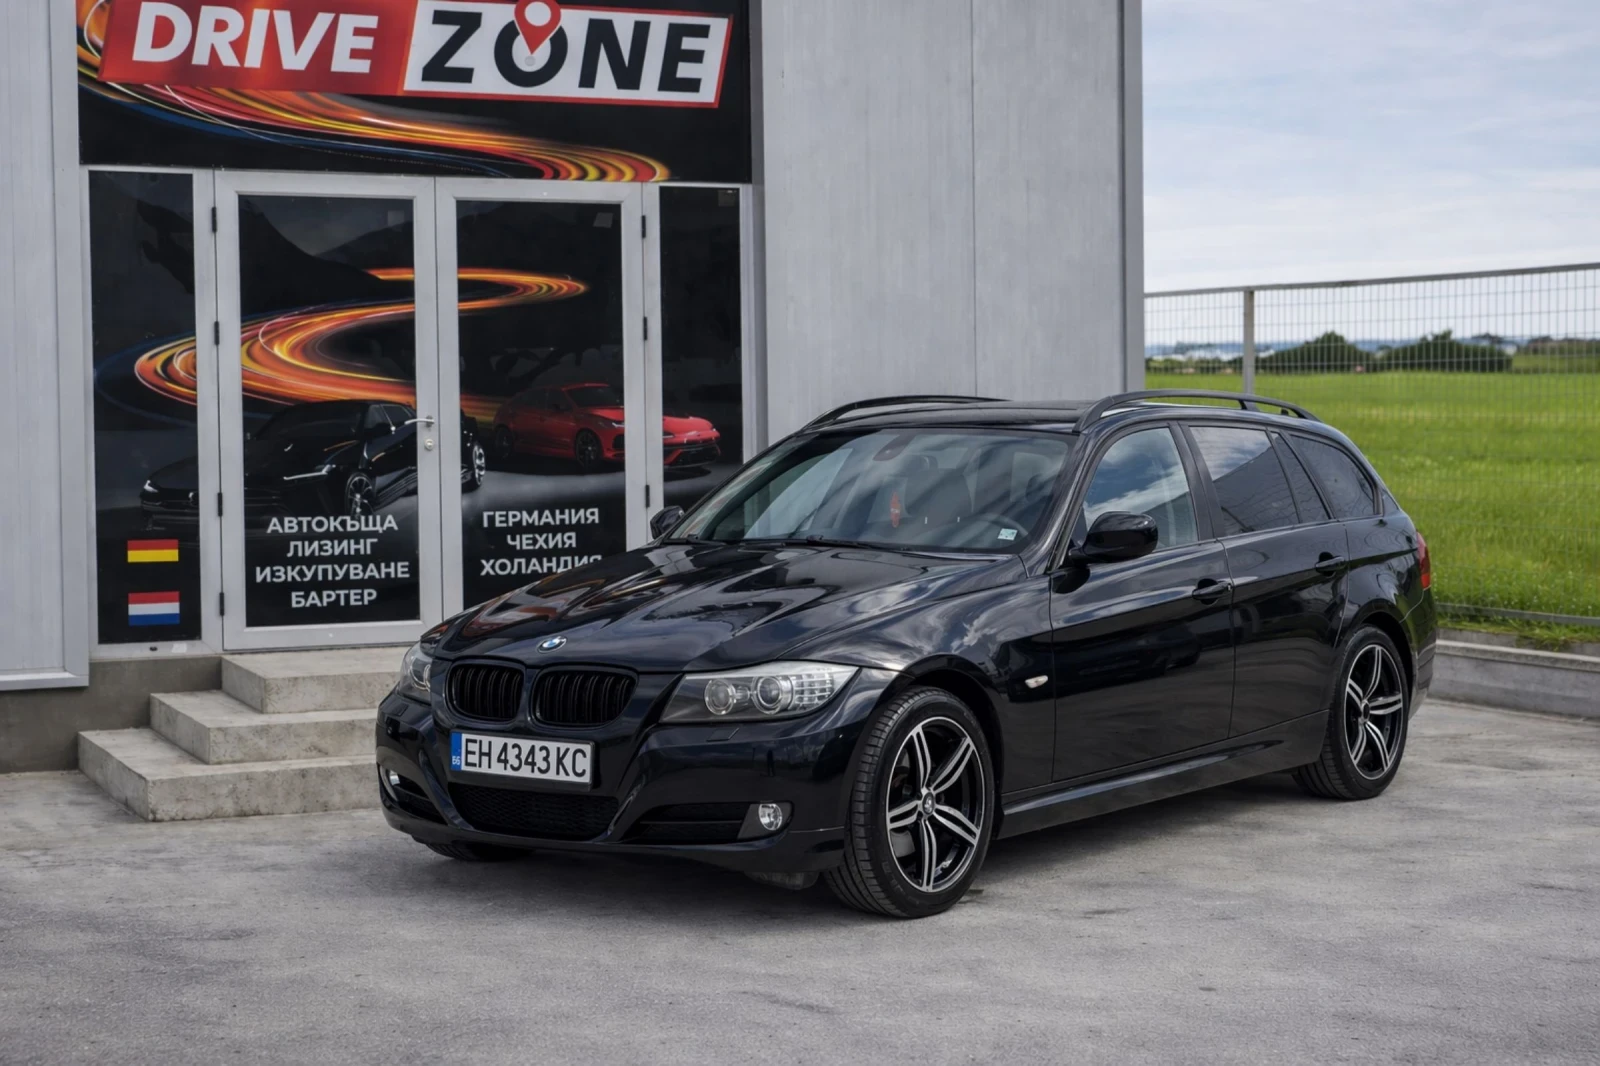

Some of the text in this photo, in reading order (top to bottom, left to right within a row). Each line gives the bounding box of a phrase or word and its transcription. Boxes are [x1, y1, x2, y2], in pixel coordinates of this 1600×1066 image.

[132, 1, 711, 93] DRIVE ZONE
[266, 514, 399, 534] АВТОКЪЩА
[482, 508, 600, 528] ГЕРМАНИЯ
[286, 538, 378, 558] ЛИЗИНГ
[506, 531, 577, 550] ЧЕХИЯ
[255, 561, 410, 583] ИЗКУПУВАНЕ
[290, 588, 377, 608] БАРТЕР
[464, 738, 587, 778] EH 4343 KC
